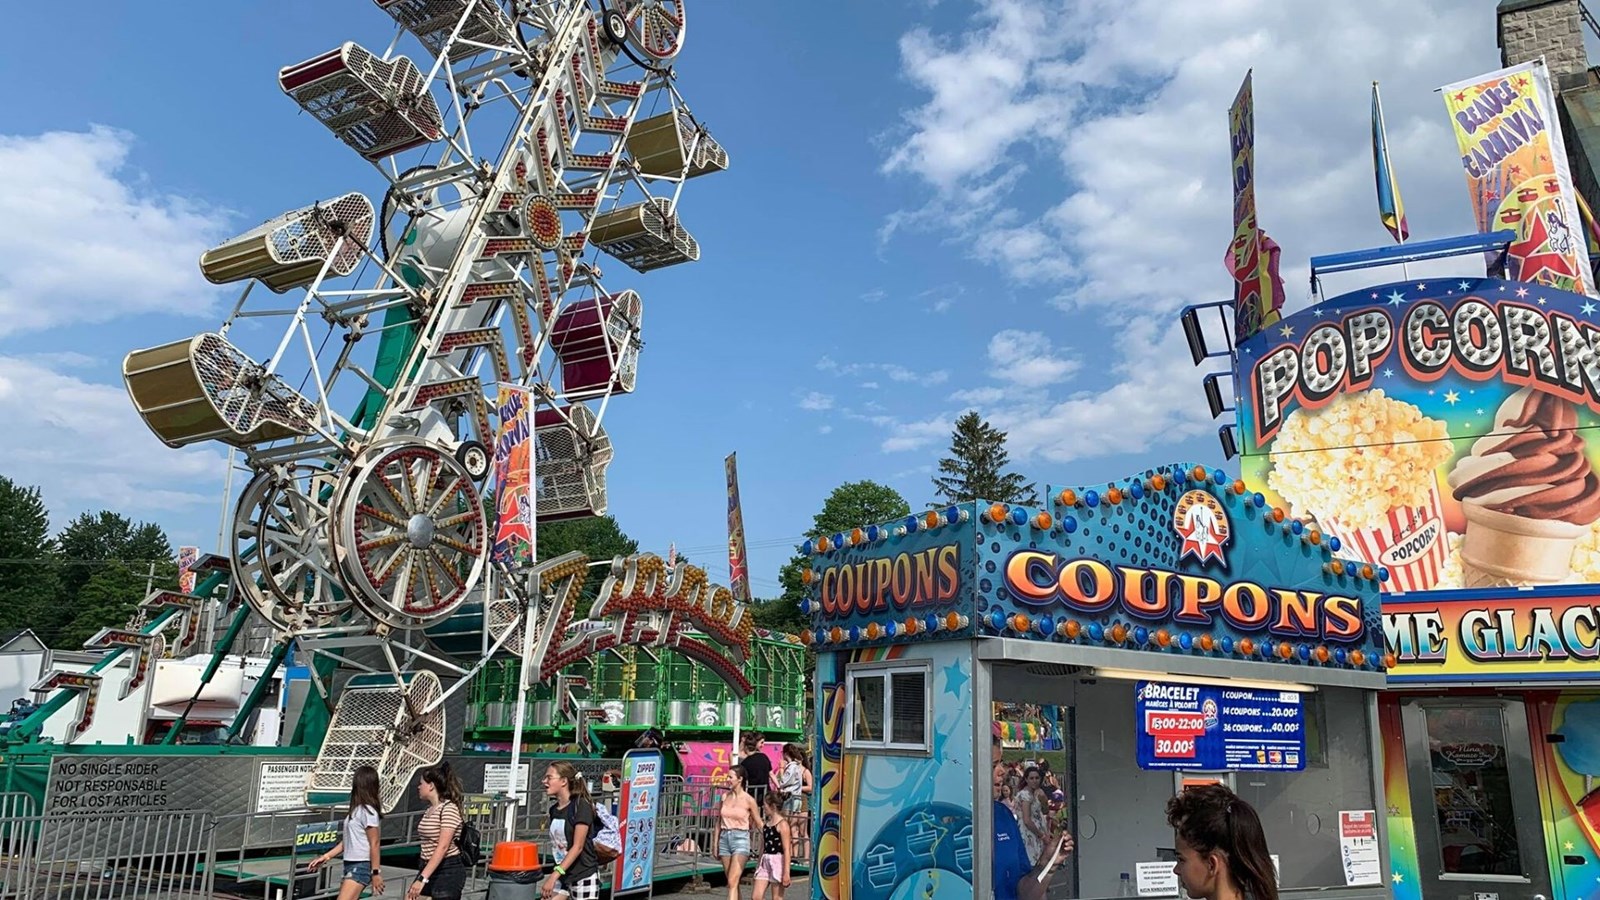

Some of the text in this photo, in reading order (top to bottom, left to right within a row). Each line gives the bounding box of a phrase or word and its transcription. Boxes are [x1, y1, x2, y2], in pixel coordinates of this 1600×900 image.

[1455, 80, 1518, 134] BEAUCE
[1255, 300, 1600, 438] POP CORN
[1391, 514, 1436, 561] POPCORN
[822, 543, 960, 615] COUPONS
[1004, 550, 1364, 638] COUPONS
[1458, 603, 1600, 664] GLAC
[1144, 683, 1200, 701] BRACELET
[1230, 707, 1261, 717] COUPONS
[1223, 723, 1231, 732] 36
[1156, 739, 1194, 754] 30.00$
[58, 763, 159, 775] NO SINGLE RIDER
[267, 765, 299, 773] PASSENGER
[55, 780, 167, 792] NOT RESPONSABLE
[52, 794, 167, 808] FOR LOST ARTICLES
[639, 790, 647, 804] 4
[296, 824, 338, 846] ENTRÉE
